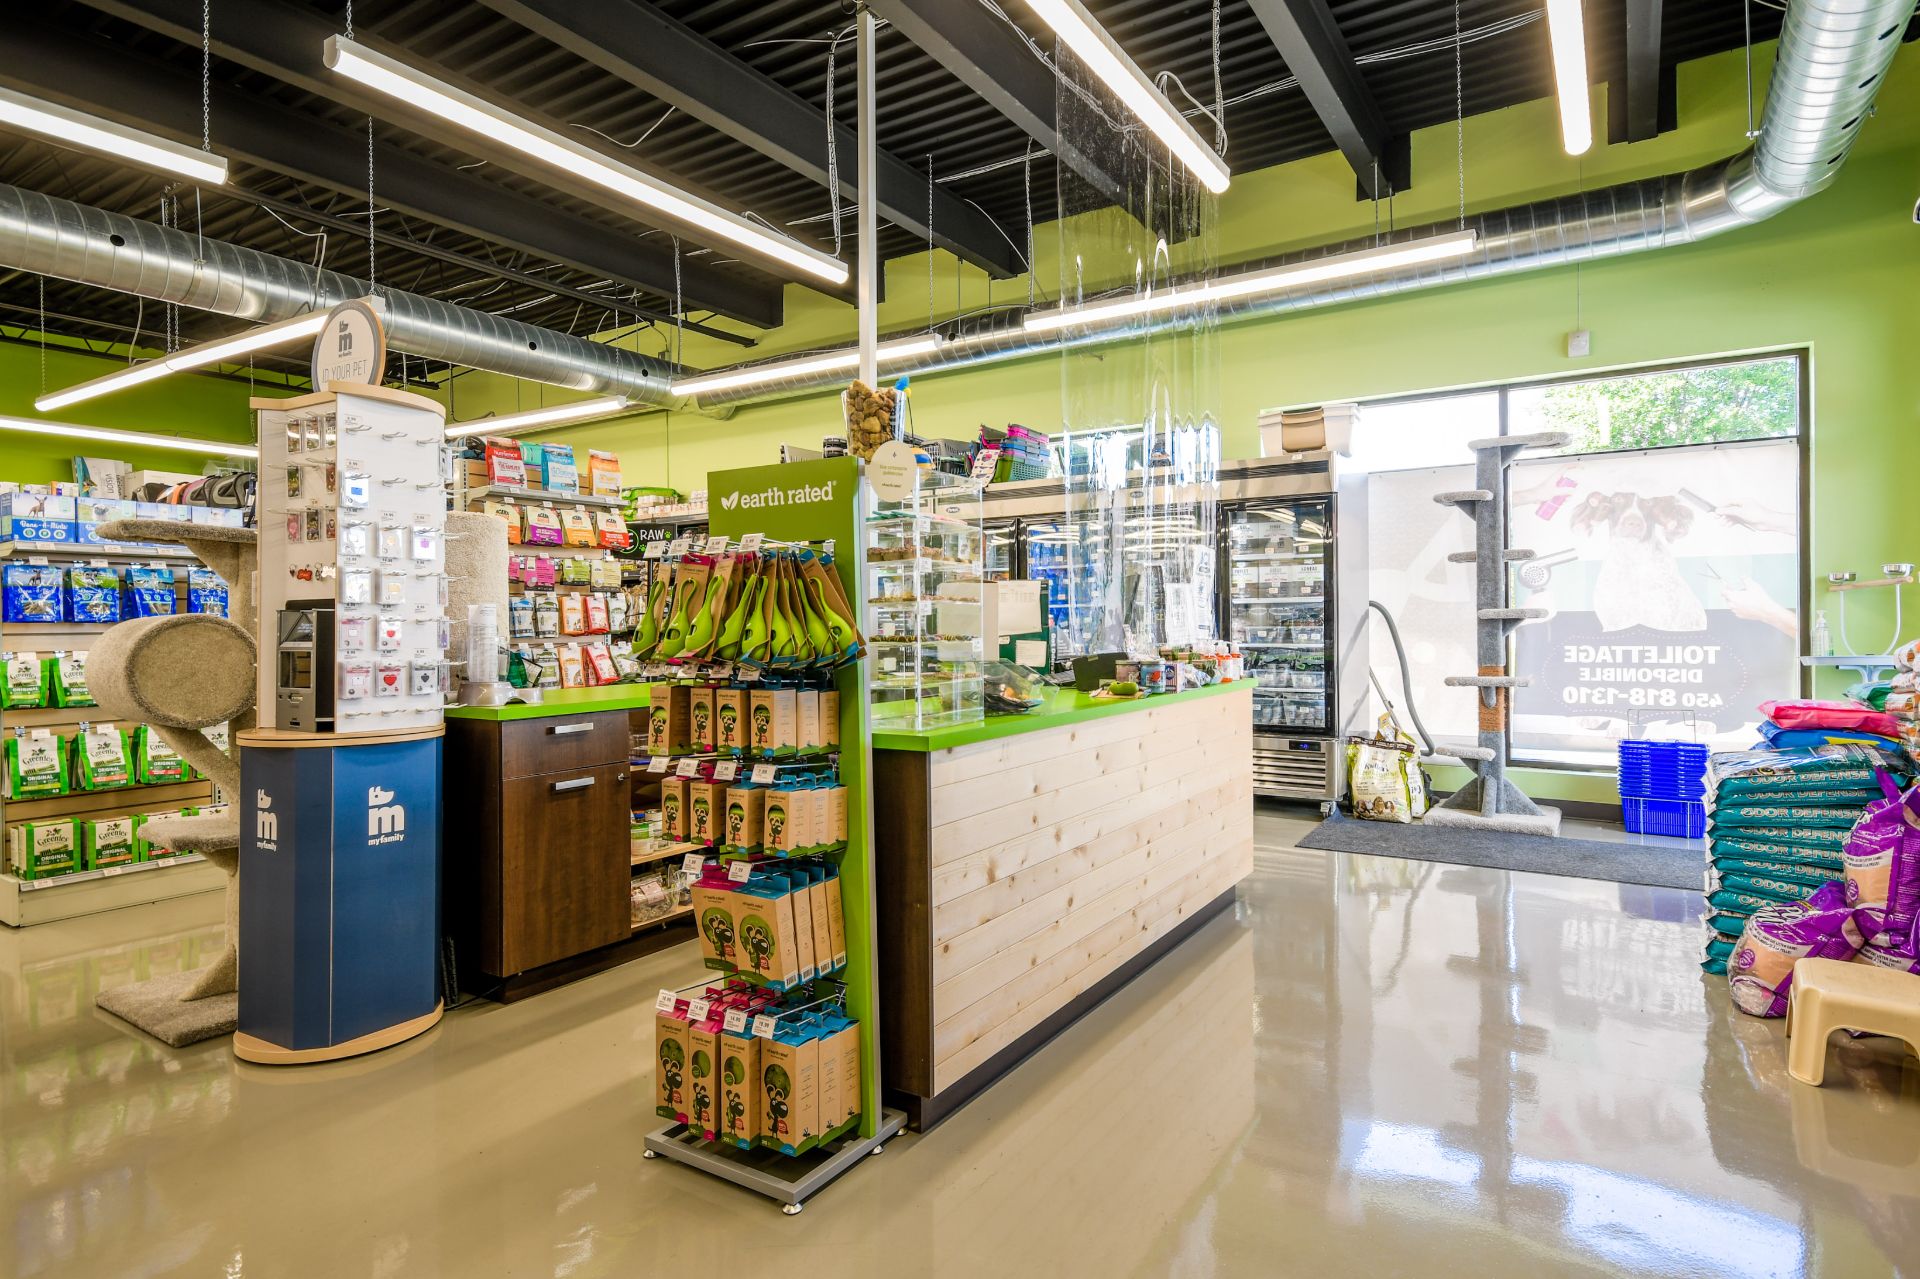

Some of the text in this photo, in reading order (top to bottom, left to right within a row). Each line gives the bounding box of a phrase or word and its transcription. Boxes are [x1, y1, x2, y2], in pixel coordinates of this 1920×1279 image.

[331, 363, 351, 380] YOUR
[352, 360, 367, 376] PET
[740, 481, 834, 509] earth rated
[640, 528, 665, 541] RAW
[1740, 807, 1789, 818] ODOR
[36, 833, 69, 847] Greenies
[98, 829, 128, 840] Greenies
[102, 847, 127, 855] ORIGINAL
[1740, 842, 1789, 856] ODOR
[41, 853, 68, 862] ORIGINAL
[1751, 877, 1799, 895] ODOR
